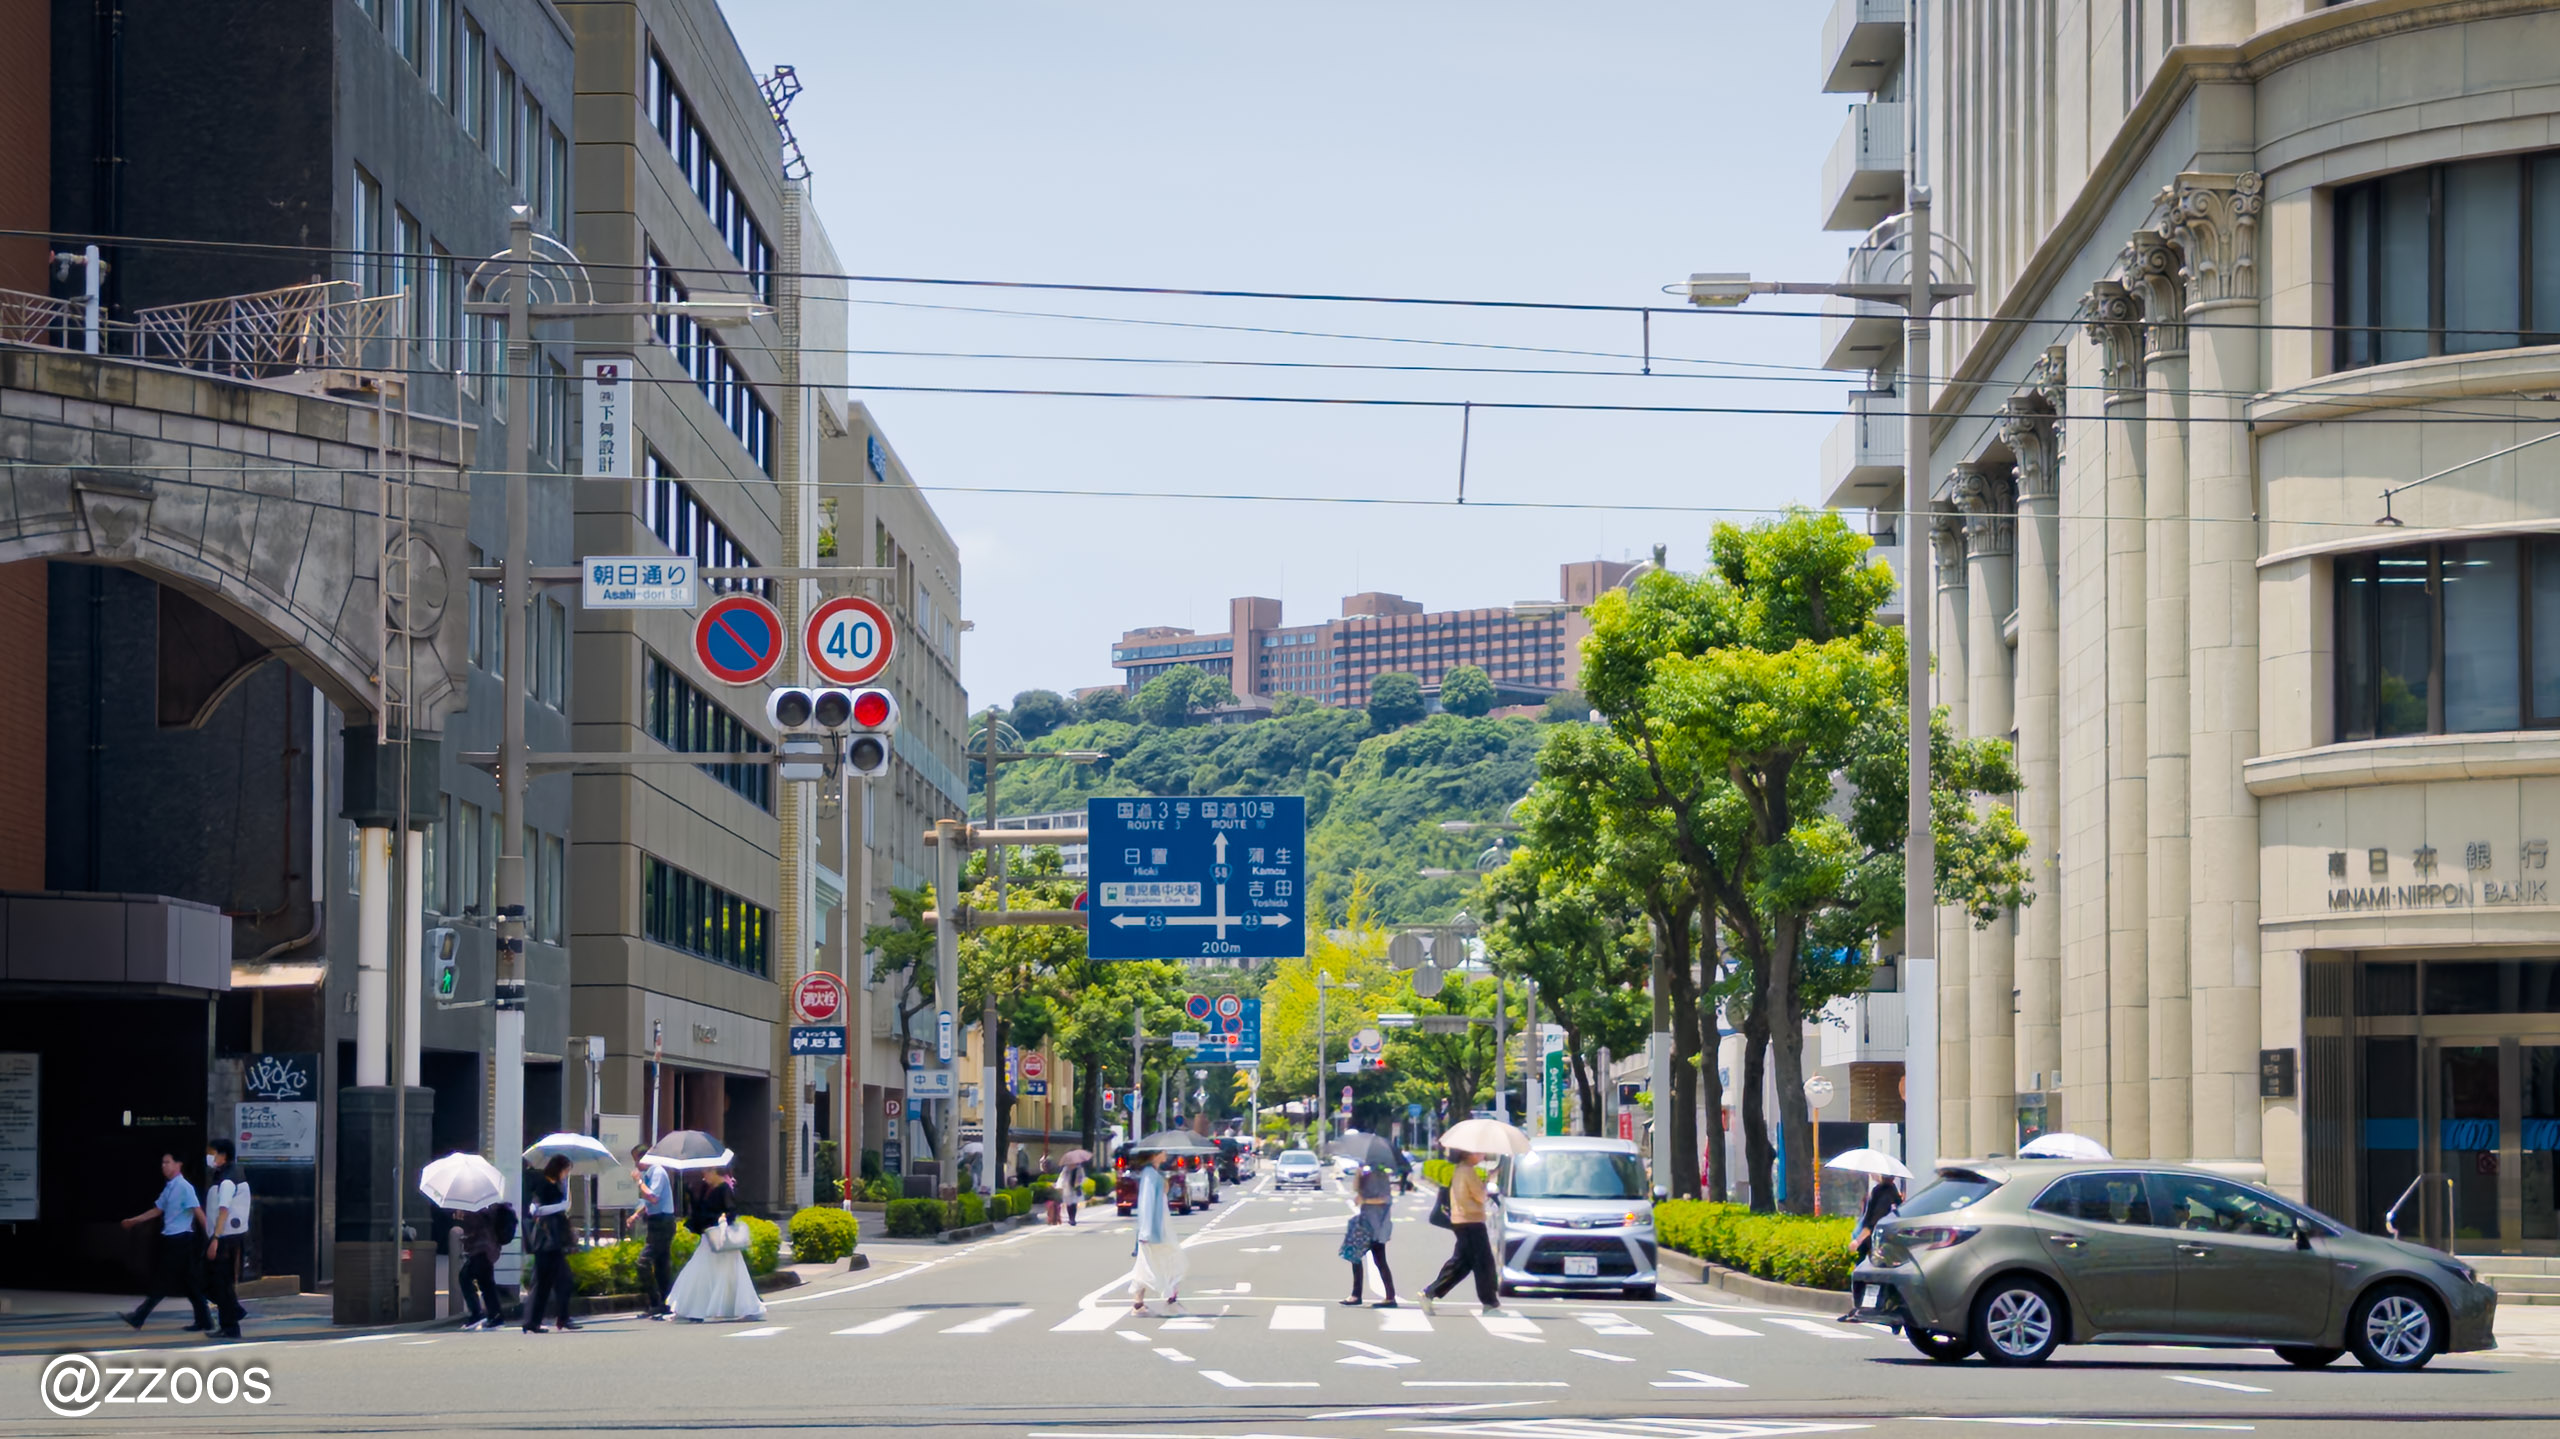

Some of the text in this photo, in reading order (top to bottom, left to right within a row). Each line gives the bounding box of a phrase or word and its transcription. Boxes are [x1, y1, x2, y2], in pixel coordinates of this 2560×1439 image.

[593, 565, 686, 586] 朝日通り
[826, 621, 873, 659] 40
[1117, 801, 1190, 819] 国道3号
[1201, 800, 1275, 819] 国道10号
[1127, 820, 1165, 830] ROUTE
[1211, 819, 1248, 829] ROUTE
[1248, 847, 1292, 865] 蒲生
[2327, 840, 2549, 877] 南日本銀行
[1133, 866, 1159, 876] Hioki
[1214, 866, 1228, 878] 58
[1124, 884, 1200, 897] 鹿児島中央駅
[1248, 880, 1293, 897] 吉田
[2484, 880, 2548, 903] BANK
[1251, 898, 1289, 908] Yoshida
[1149, 915, 1163, 927] 25
[1245, 914, 1259, 926] 25
[1201, 941, 1241, 954] 200m
[802, 990, 836, 1007] 消火栓
